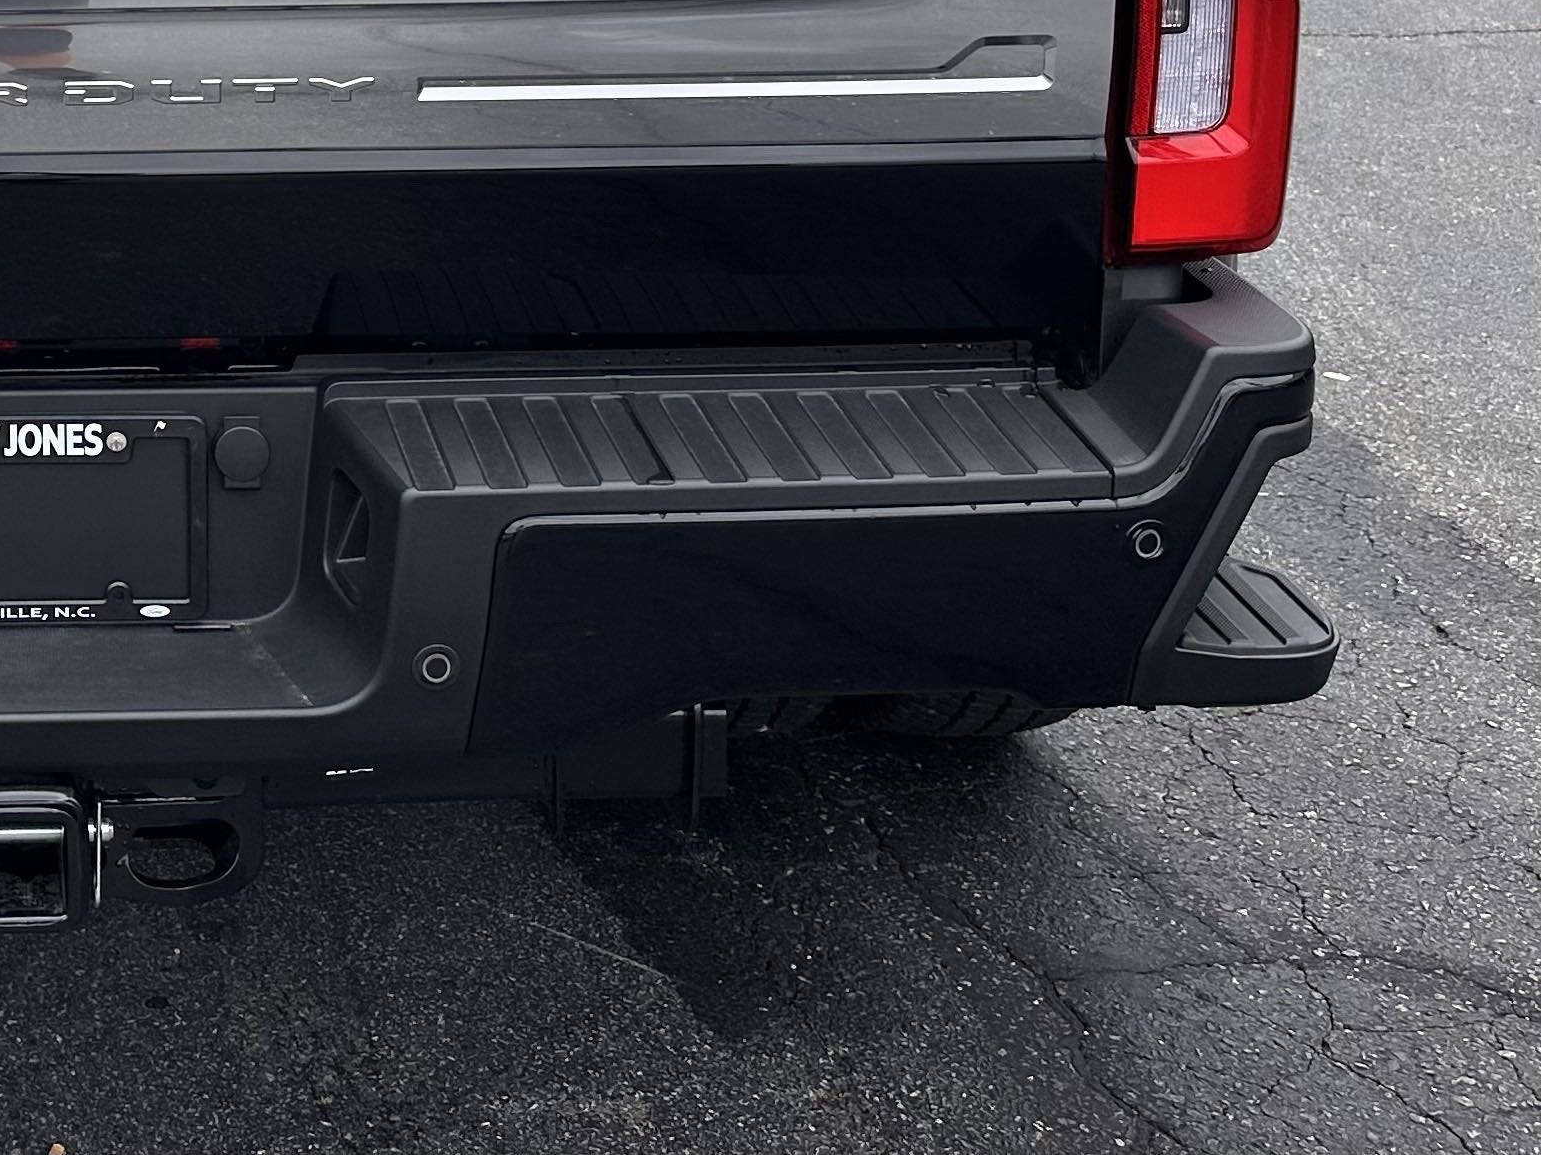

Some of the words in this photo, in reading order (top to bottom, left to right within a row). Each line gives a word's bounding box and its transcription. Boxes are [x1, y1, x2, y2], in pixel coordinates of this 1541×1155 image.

[63, 76, 375, 106] DUTY
[3, 422, 104, 457] JONES
[54, 606, 96, 619] N.C.
